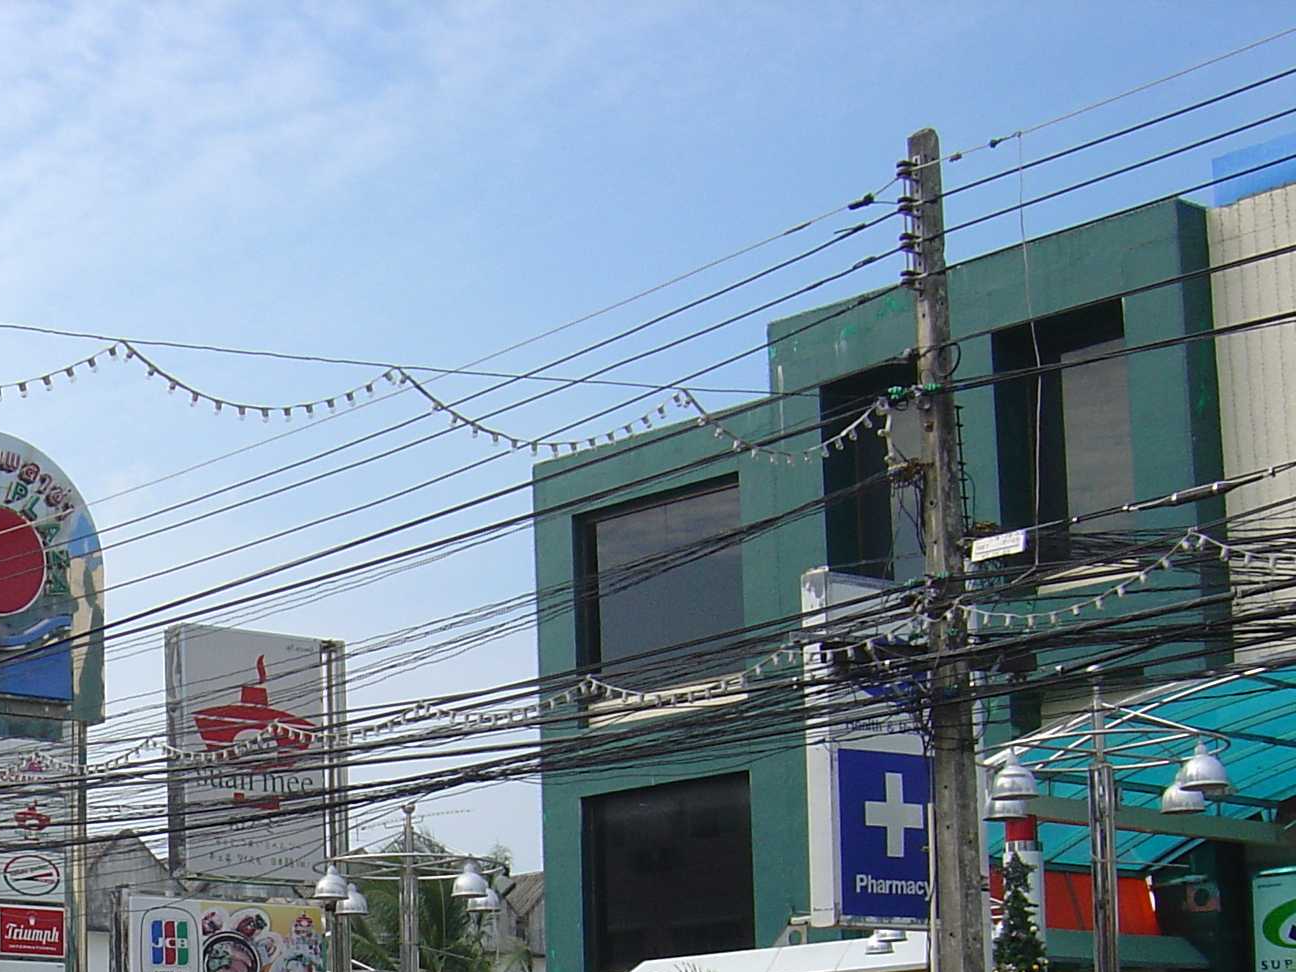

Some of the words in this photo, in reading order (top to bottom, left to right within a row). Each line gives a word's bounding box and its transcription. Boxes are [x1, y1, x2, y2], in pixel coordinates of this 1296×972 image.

[262, 772, 314, 793] mee
[855, 873, 932, 902] Pharmacy
[5, 922, 60, 945] Triumph
[152, 937, 188, 948] JCB
